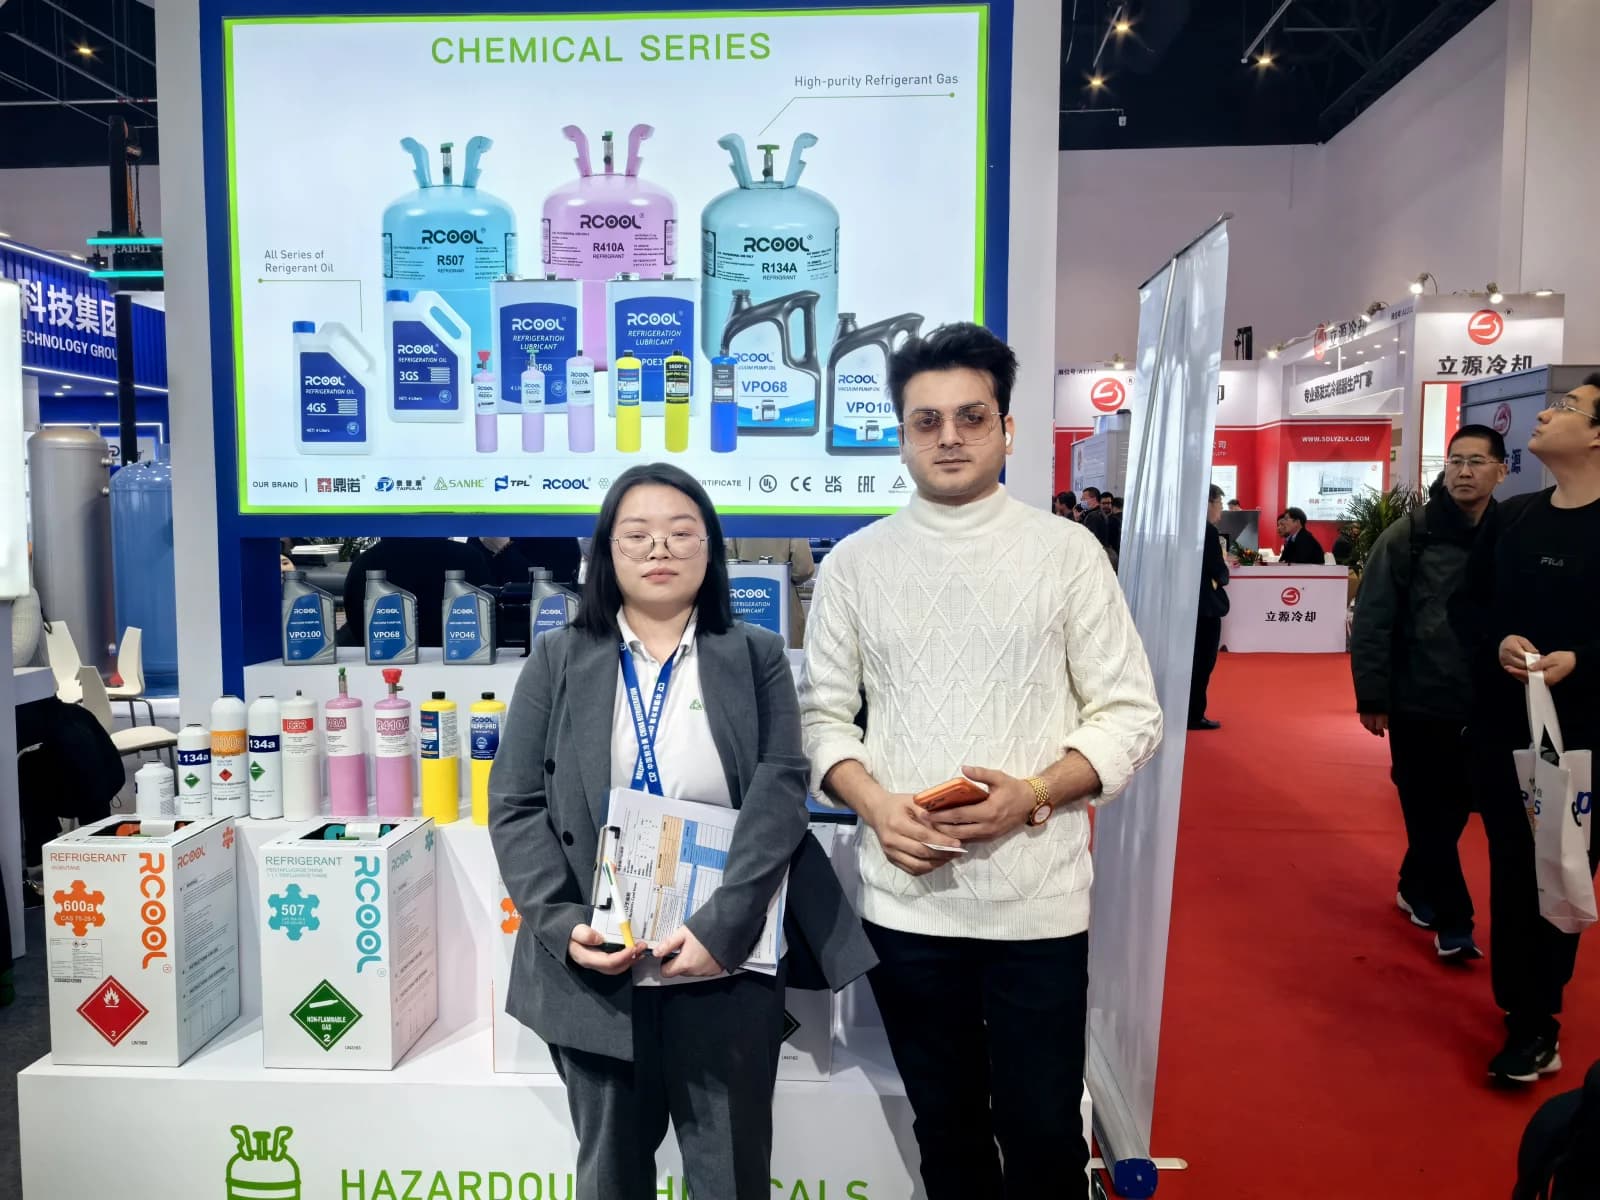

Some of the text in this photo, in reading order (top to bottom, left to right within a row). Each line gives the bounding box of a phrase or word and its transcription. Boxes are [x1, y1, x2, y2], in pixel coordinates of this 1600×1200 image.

[431, 32, 771, 64] CHEMICAL SERIES
[794, 73, 959, 88] High-purity Refrigerant Gas
[580, 214, 642, 229] RCOOL
[421, 229, 484, 245] RCOOL
[592, 242, 625, 252] R410A
[743, 236, 810, 252] RCOOL
[264, 249, 325, 260] All Series of
[437, 255, 465, 266] R507
[265, 263, 334, 274] Rerigerant Oil
[761, 262, 798, 273] R134A
[18, 278, 117, 338] 科技集团
[511, 318, 565, 331] RCOOL
[627, 313, 681, 326] RCOOL
[21, 329, 118, 361] ECHNOLOGY GROU
[398, 344, 438, 355] RCOOL
[642, 358, 666, 366] POE3
[734, 353, 773, 363] RCOOL
[1437, 354, 1533, 376] 立源冷却
[305, 375, 345, 386] RCOOL
[399, 371, 420, 381] 3GS
[838, 375, 878, 384] RCOOL
[741, 381, 788, 393] VPO68
[306, 402, 327, 413] 4GS
[449, 479, 485, 488] SANHE
[542, 478, 590, 490] RCOOL
[790, 476, 812, 491] CE
[825, 475, 842, 484] UK
[825, 484, 842, 493] CA
[1540, 556, 1564, 568] FILA
[1265, 610, 1317, 623] 立源冷却
[288, 630, 322, 639] VPO100
[373, 630, 400, 638] VPO68
[449, 631, 476, 639] VPO46
[250, 739, 276, 748] 134a
[50, 852, 129, 863] REFRIGERANT
[265, 856, 343, 866] REFRIGERANT
[63, 900, 95, 912] 600a
[139, 852, 168, 970] RCOOL
[281, 904, 305, 916] 507
[354, 855, 382, 974] RCOOL
[321, 1023, 332, 1031] GAS
[323, 1033, 331, 1042] 2
[341, 1168, 573, 1200] HAZARDOU
